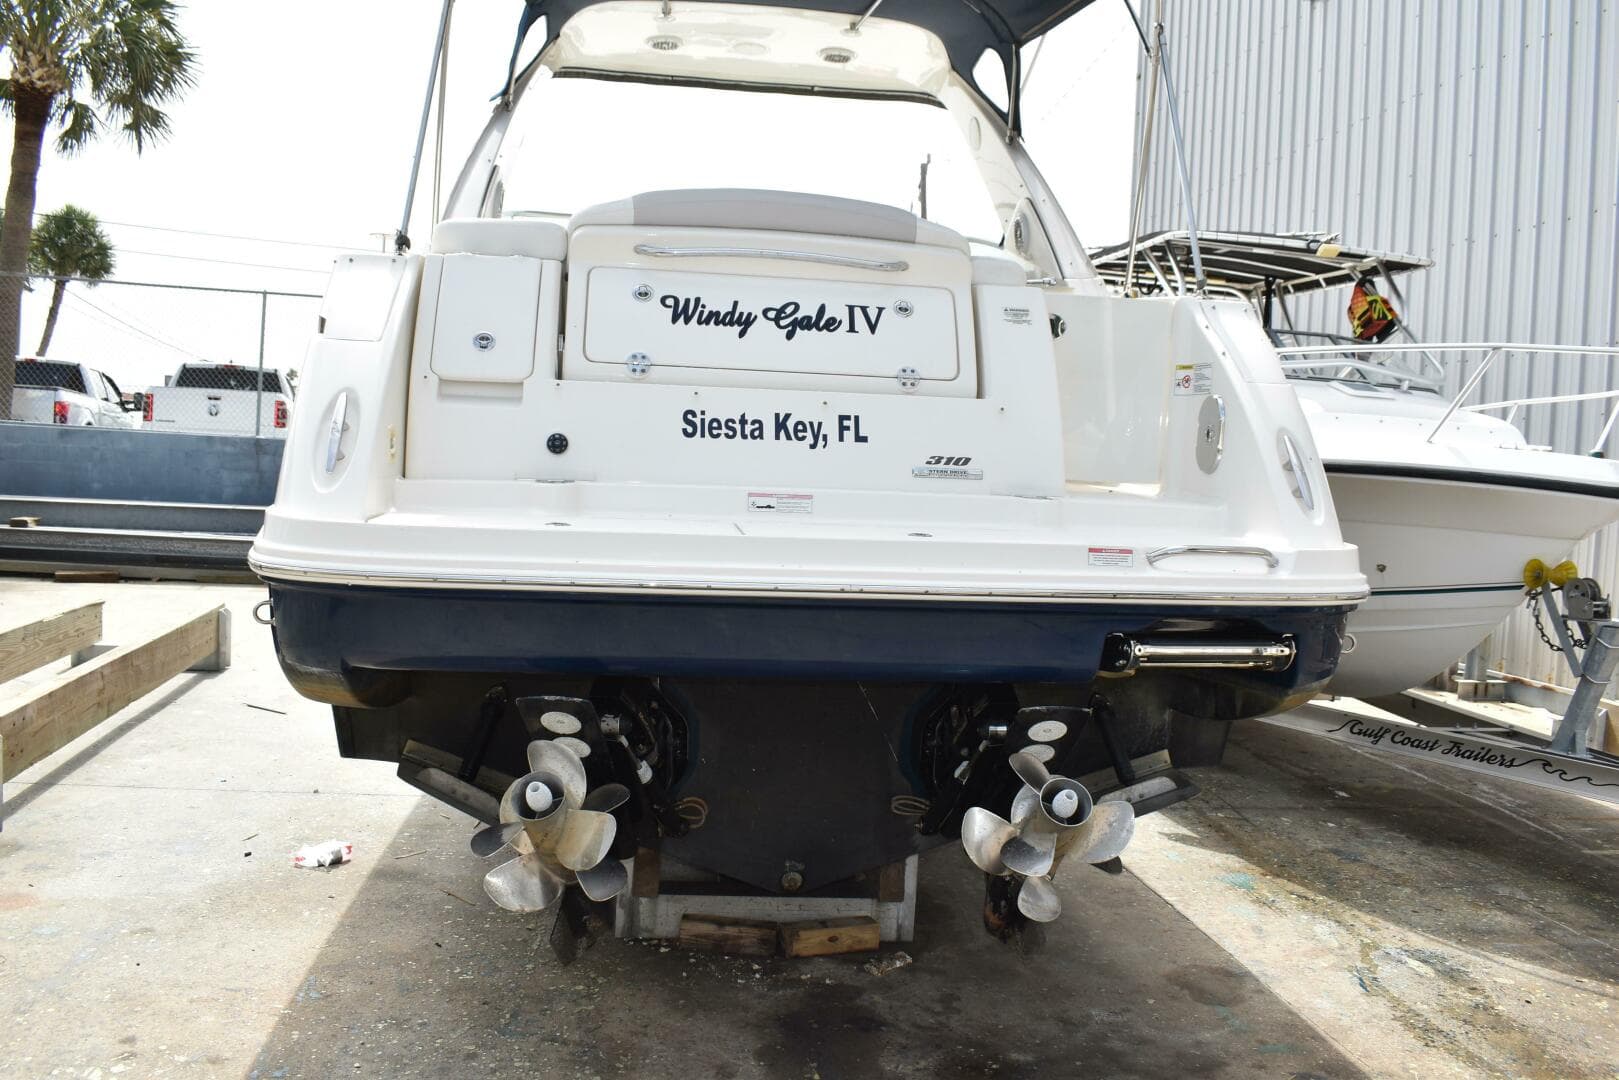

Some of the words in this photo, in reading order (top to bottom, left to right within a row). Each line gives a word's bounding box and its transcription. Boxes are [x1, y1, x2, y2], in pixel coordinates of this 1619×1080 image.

[660, 294, 757, 339] Windy
[762, 301, 842, 341] Gale
[845, 304, 886, 335] IV
[682, 409, 764, 440] Siesta
[774, 412, 828, 450] Key,
[838, 414, 869, 443] FL
[925, 456, 972, 466] 310
[1350, 719, 1392, 746] Gulf
[1391, 731, 1442, 752] Coast
[1442, 740, 1517, 768] Trailers
